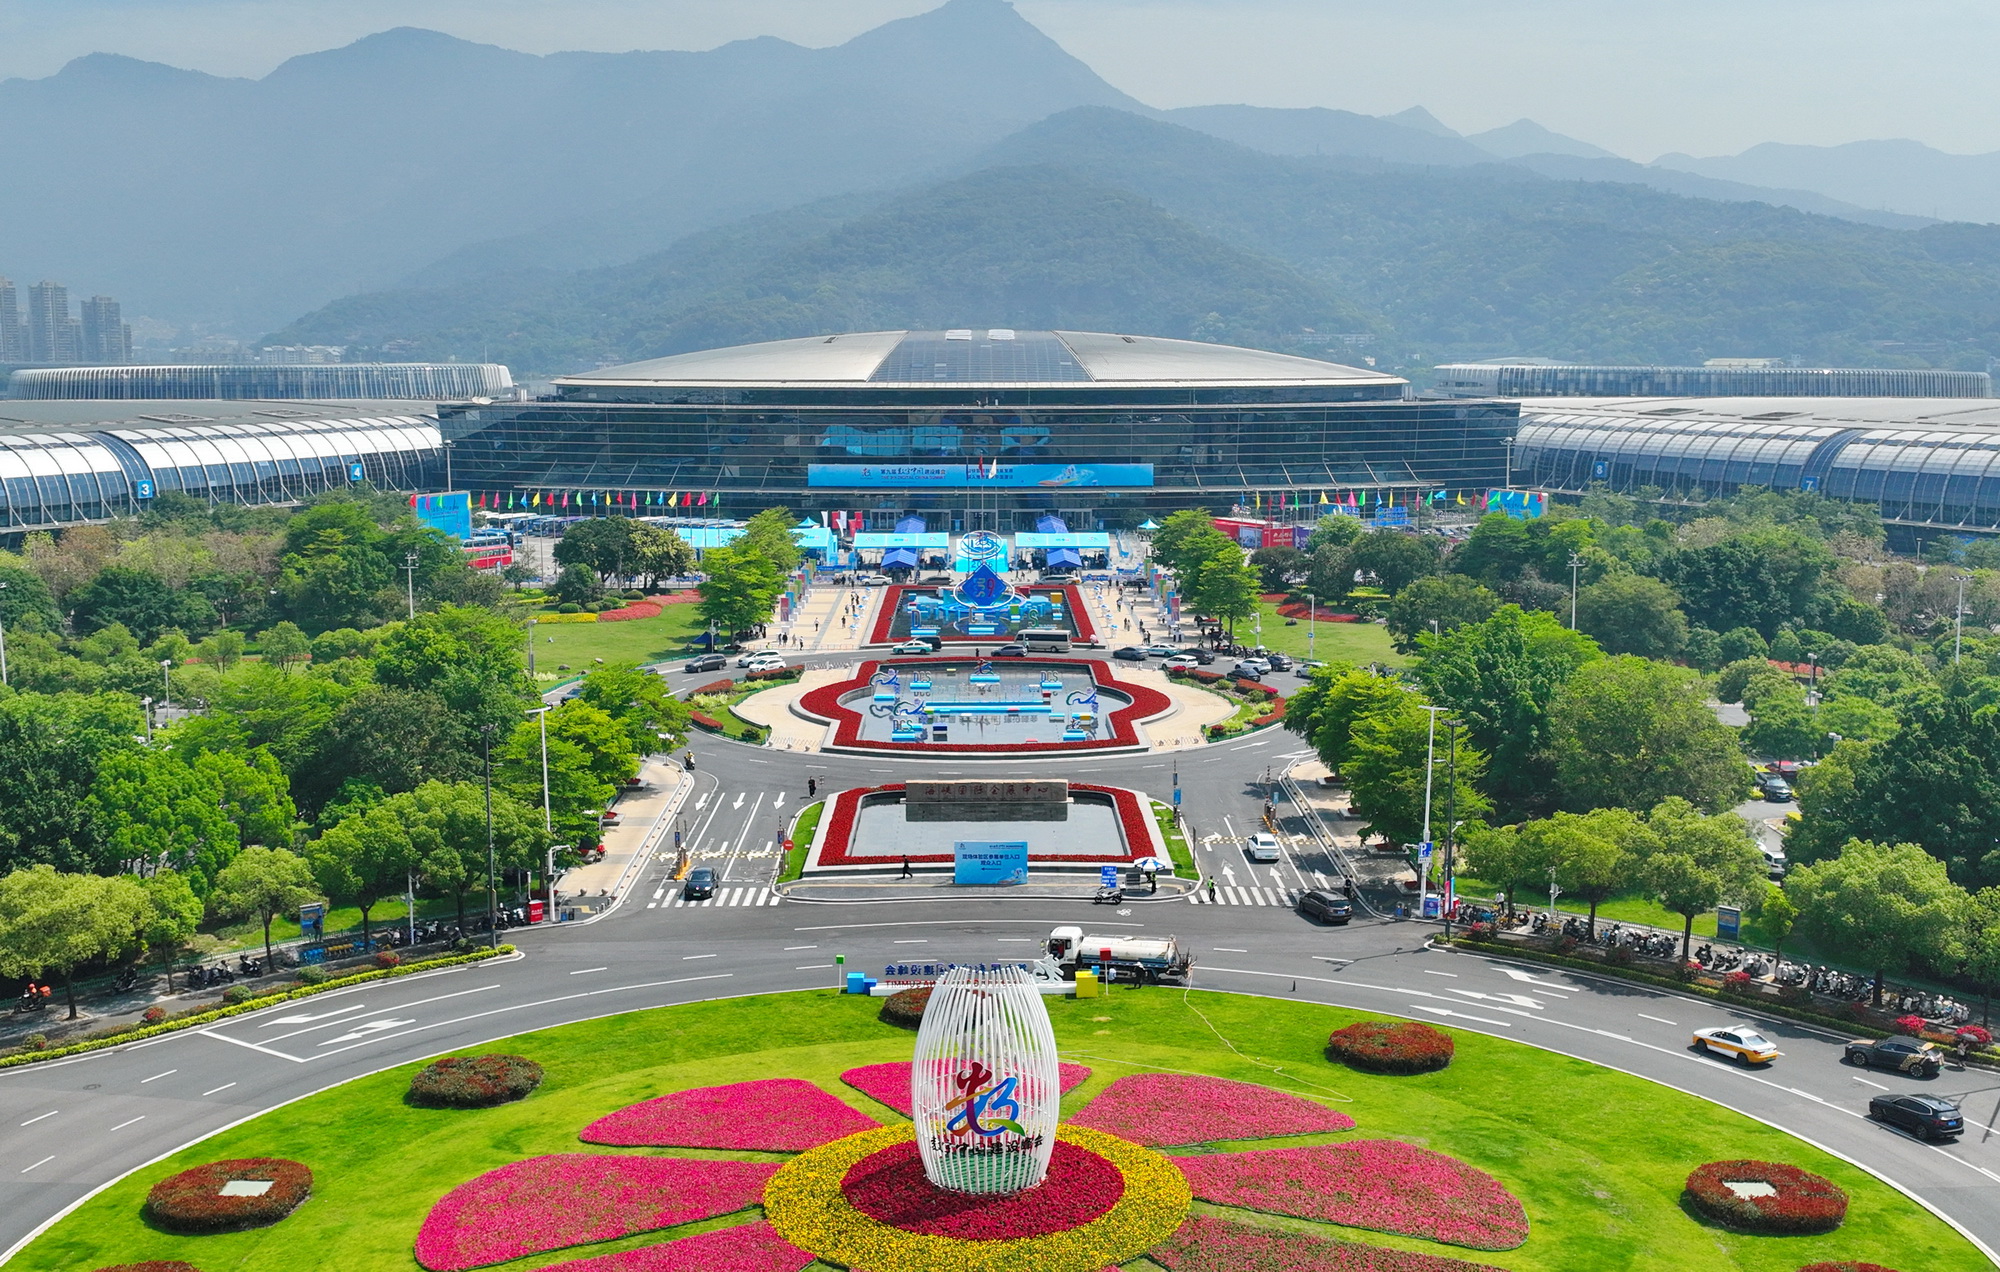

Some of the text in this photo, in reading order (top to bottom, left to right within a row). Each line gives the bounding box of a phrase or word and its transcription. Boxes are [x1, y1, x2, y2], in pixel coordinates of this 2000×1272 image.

[354, 467, 361, 477] 4
[1596, 465, 1603, 474] 8
[141, 484, 150, 495] 3
[1805, 480, 1813, 491] 7
[1041, 671, 1059, 682] DCS
